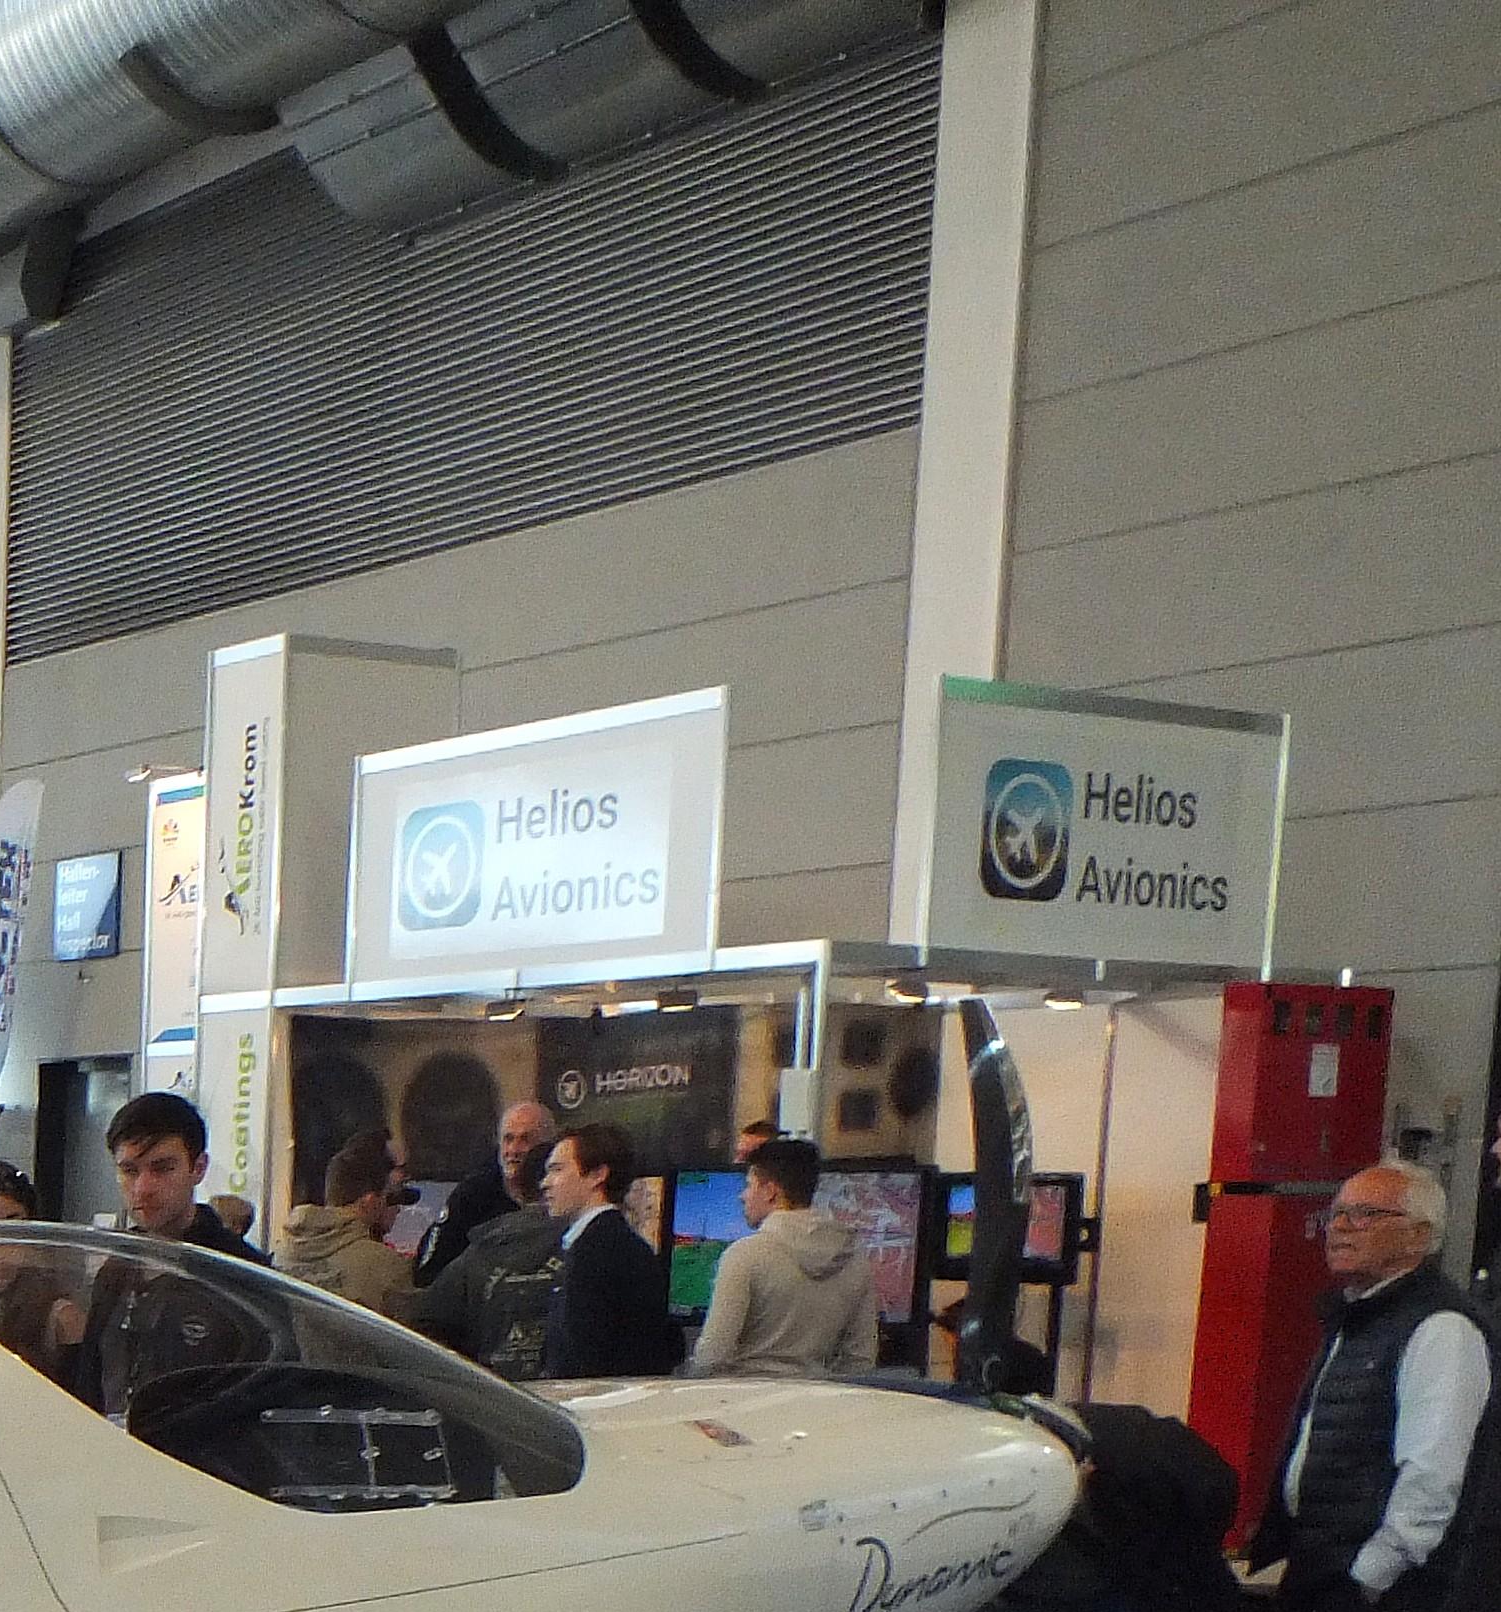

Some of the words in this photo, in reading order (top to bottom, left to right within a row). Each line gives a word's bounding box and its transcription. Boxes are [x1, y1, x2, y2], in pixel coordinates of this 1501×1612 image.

[495, 790, 619, 846] Helios
[1083, 771, 1198, 828] Helios
[490, 863, 660, 923] Avionics
[1076, 855, 1229, 913] Avionics
[229, 1032, 256, 1193] Coatings
